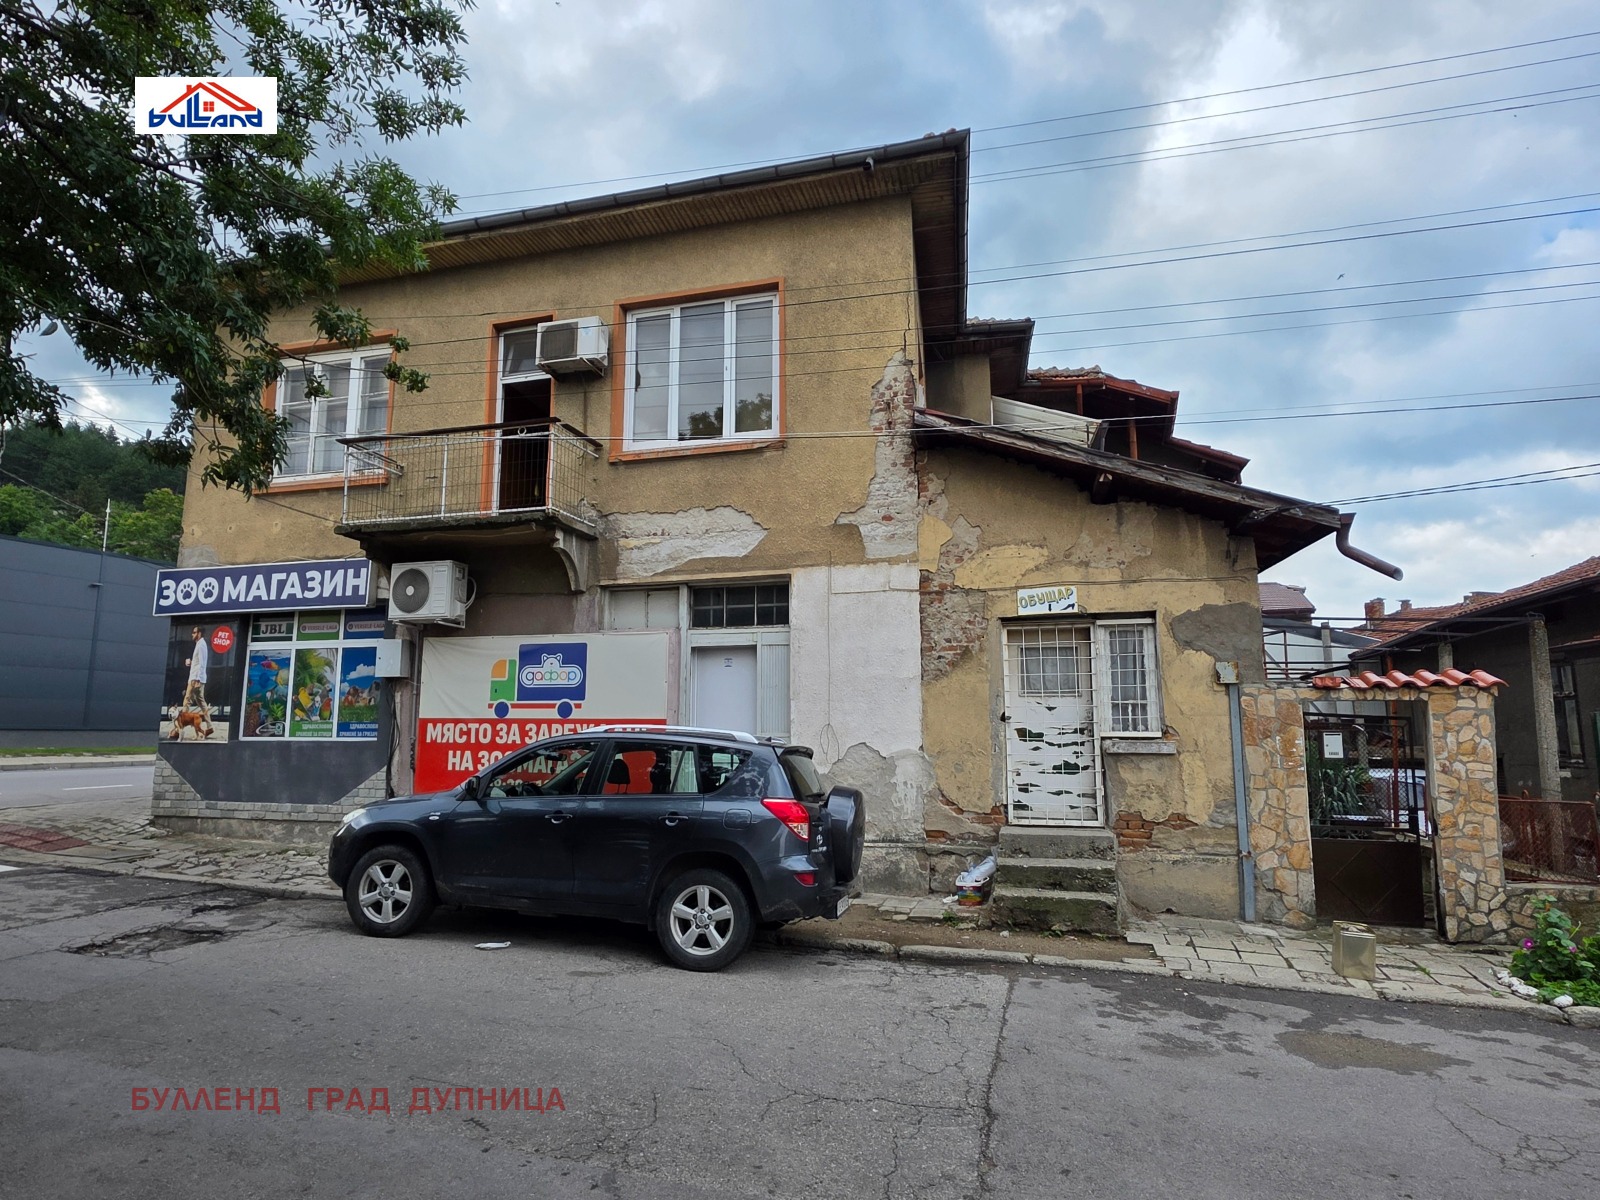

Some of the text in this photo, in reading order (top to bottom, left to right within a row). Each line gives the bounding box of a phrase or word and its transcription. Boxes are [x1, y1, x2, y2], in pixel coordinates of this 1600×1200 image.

[1018, 587, 1074, 609] ОБУЩАР
[217, 631, 230, 639] PET
[262, 624, 285, 634] JBL
[213, 637, 231, 646] SHOP
[426, 723, 492, 743] МЯСТО
[495, 723, 521, 744] ЗА
[447, 750, 474, 771] НА
